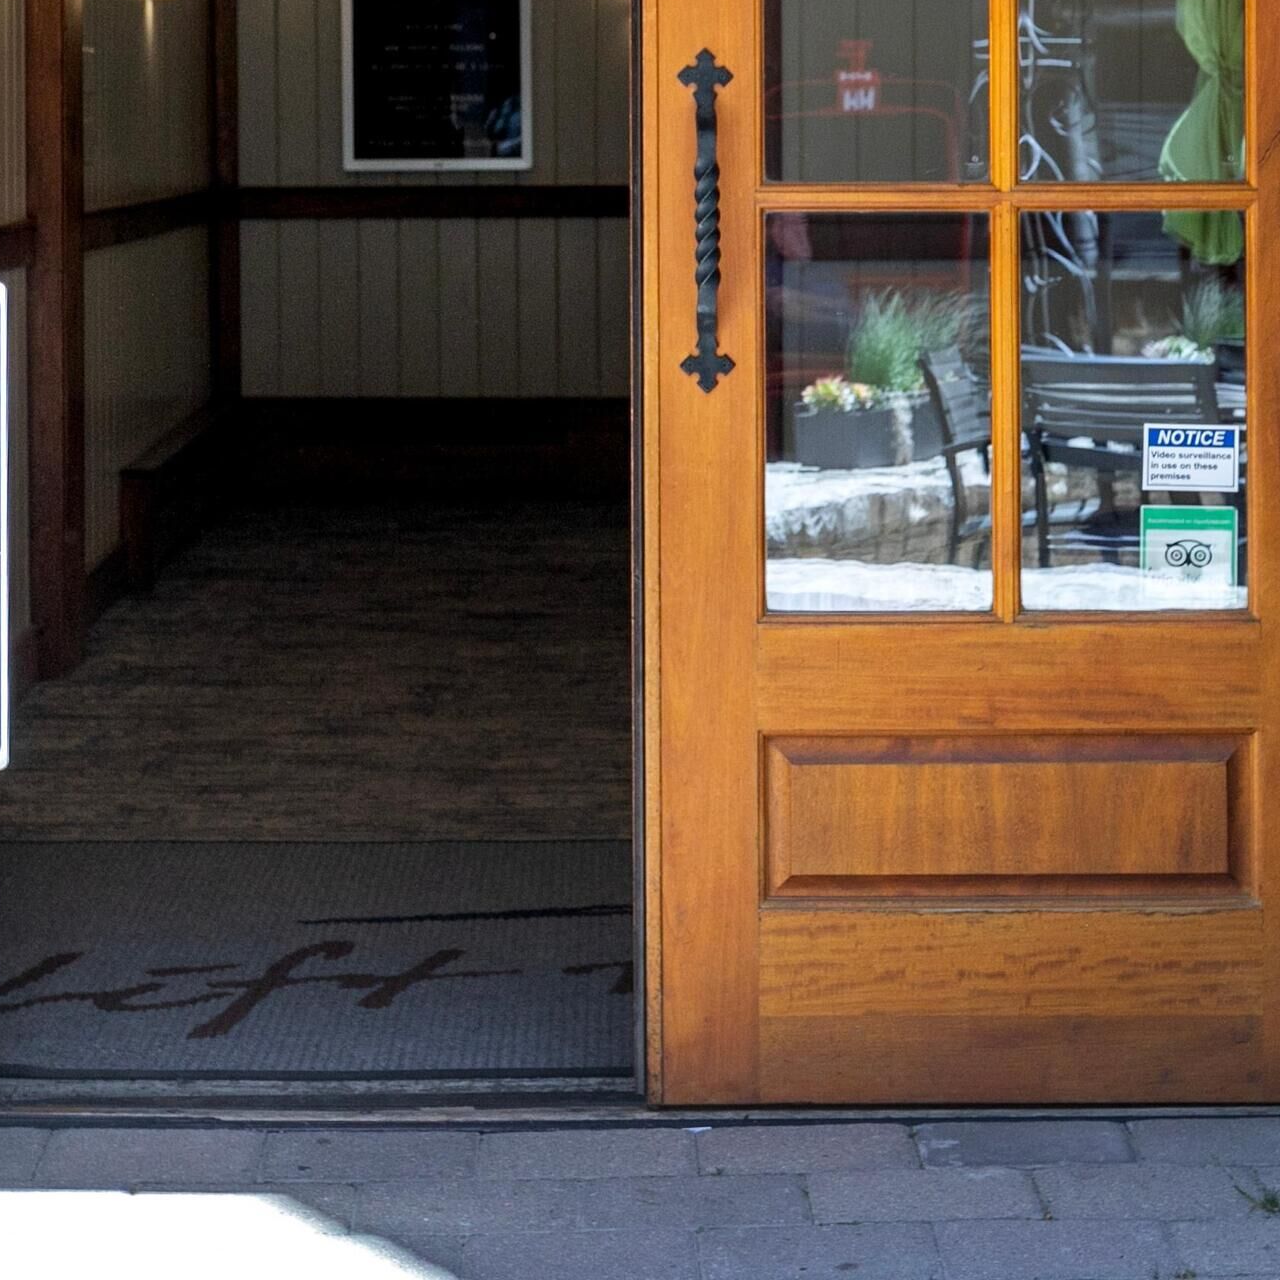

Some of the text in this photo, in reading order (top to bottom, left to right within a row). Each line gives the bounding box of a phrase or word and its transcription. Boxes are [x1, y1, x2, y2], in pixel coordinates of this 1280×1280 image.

[1157, 430, 1226, 446] NOTICE
[1151, 451, 1232, 460] Video surveillance
[1194, 462, 1218, 470] these
[1150, 472, 1191, 481] premises
